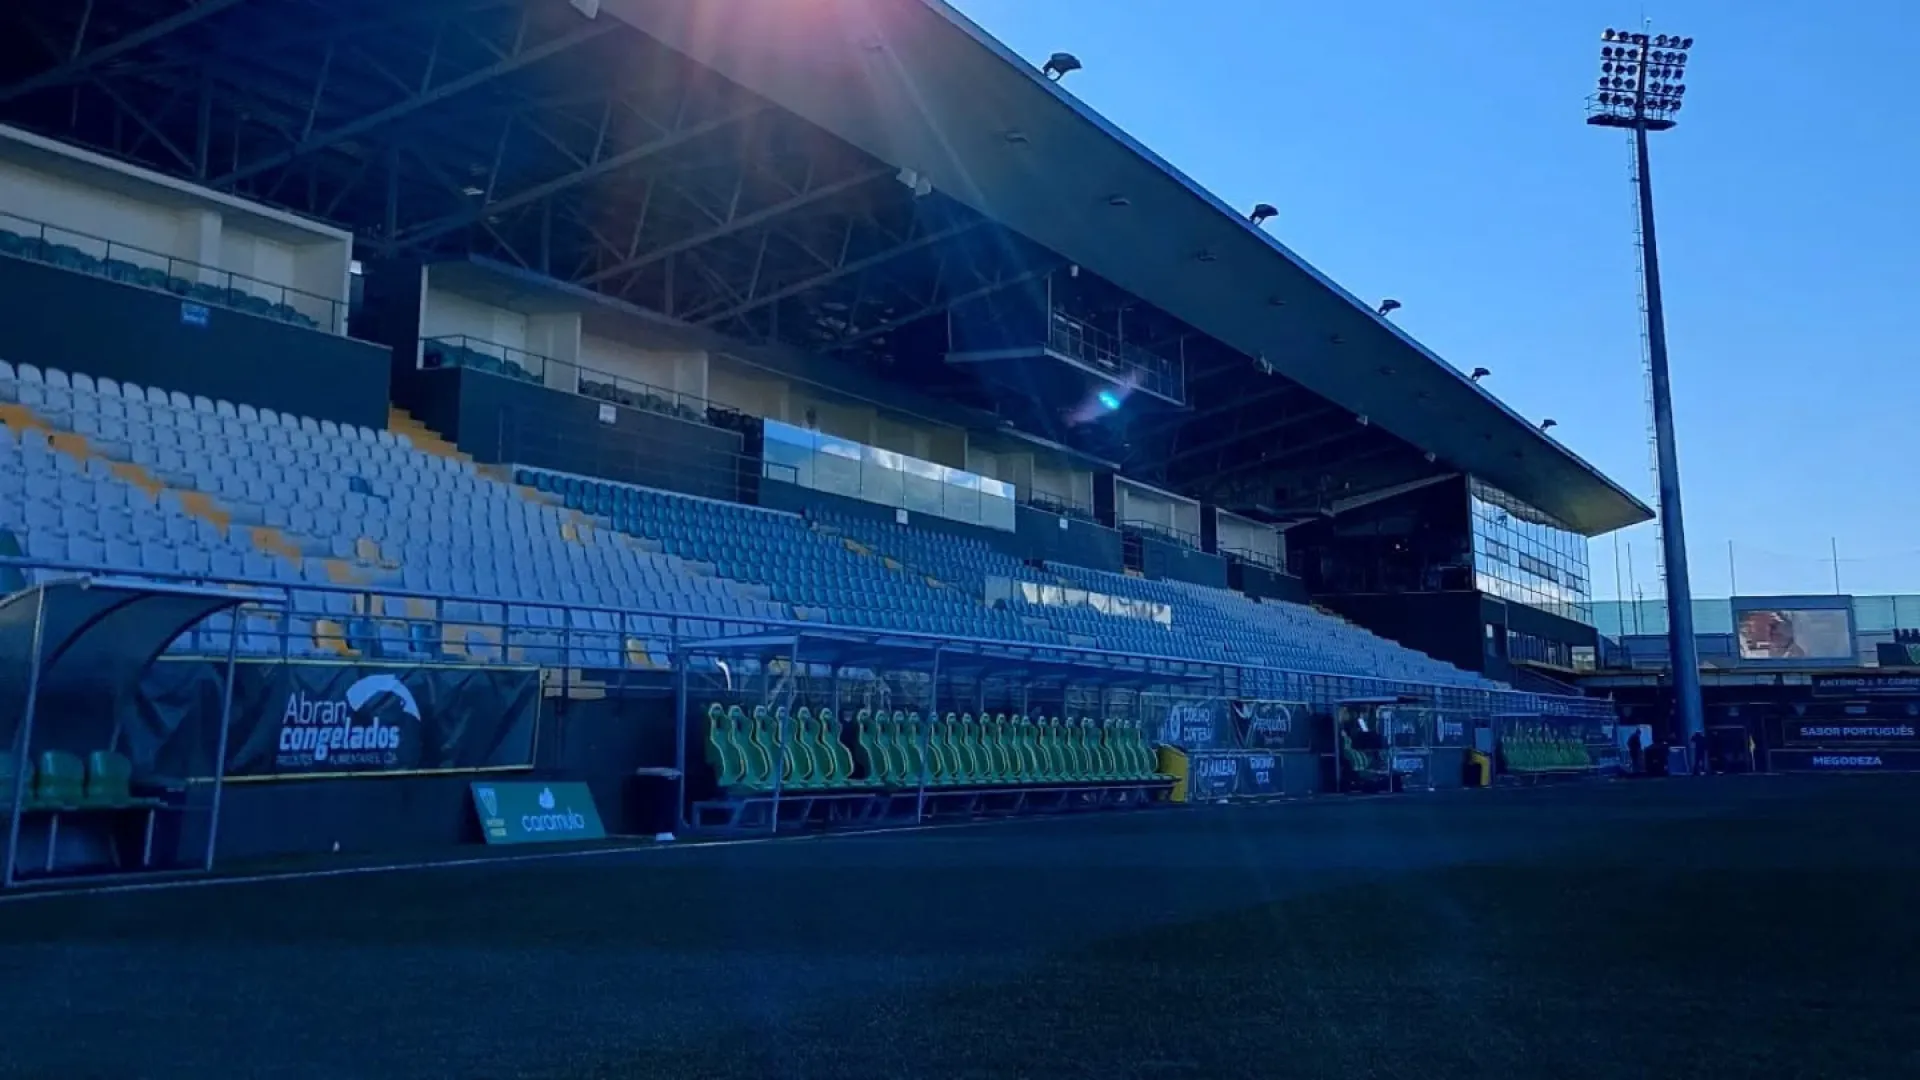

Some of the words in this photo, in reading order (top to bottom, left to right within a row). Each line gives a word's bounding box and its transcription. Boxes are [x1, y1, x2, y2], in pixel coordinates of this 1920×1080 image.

[282, 691, 347, 725] Abran
[279, 716, 400, 760] congelados
[1843, 724, 1916, 737] PORTUGUÊS
[1812, 755, 1883, 766] MEGODEZA
